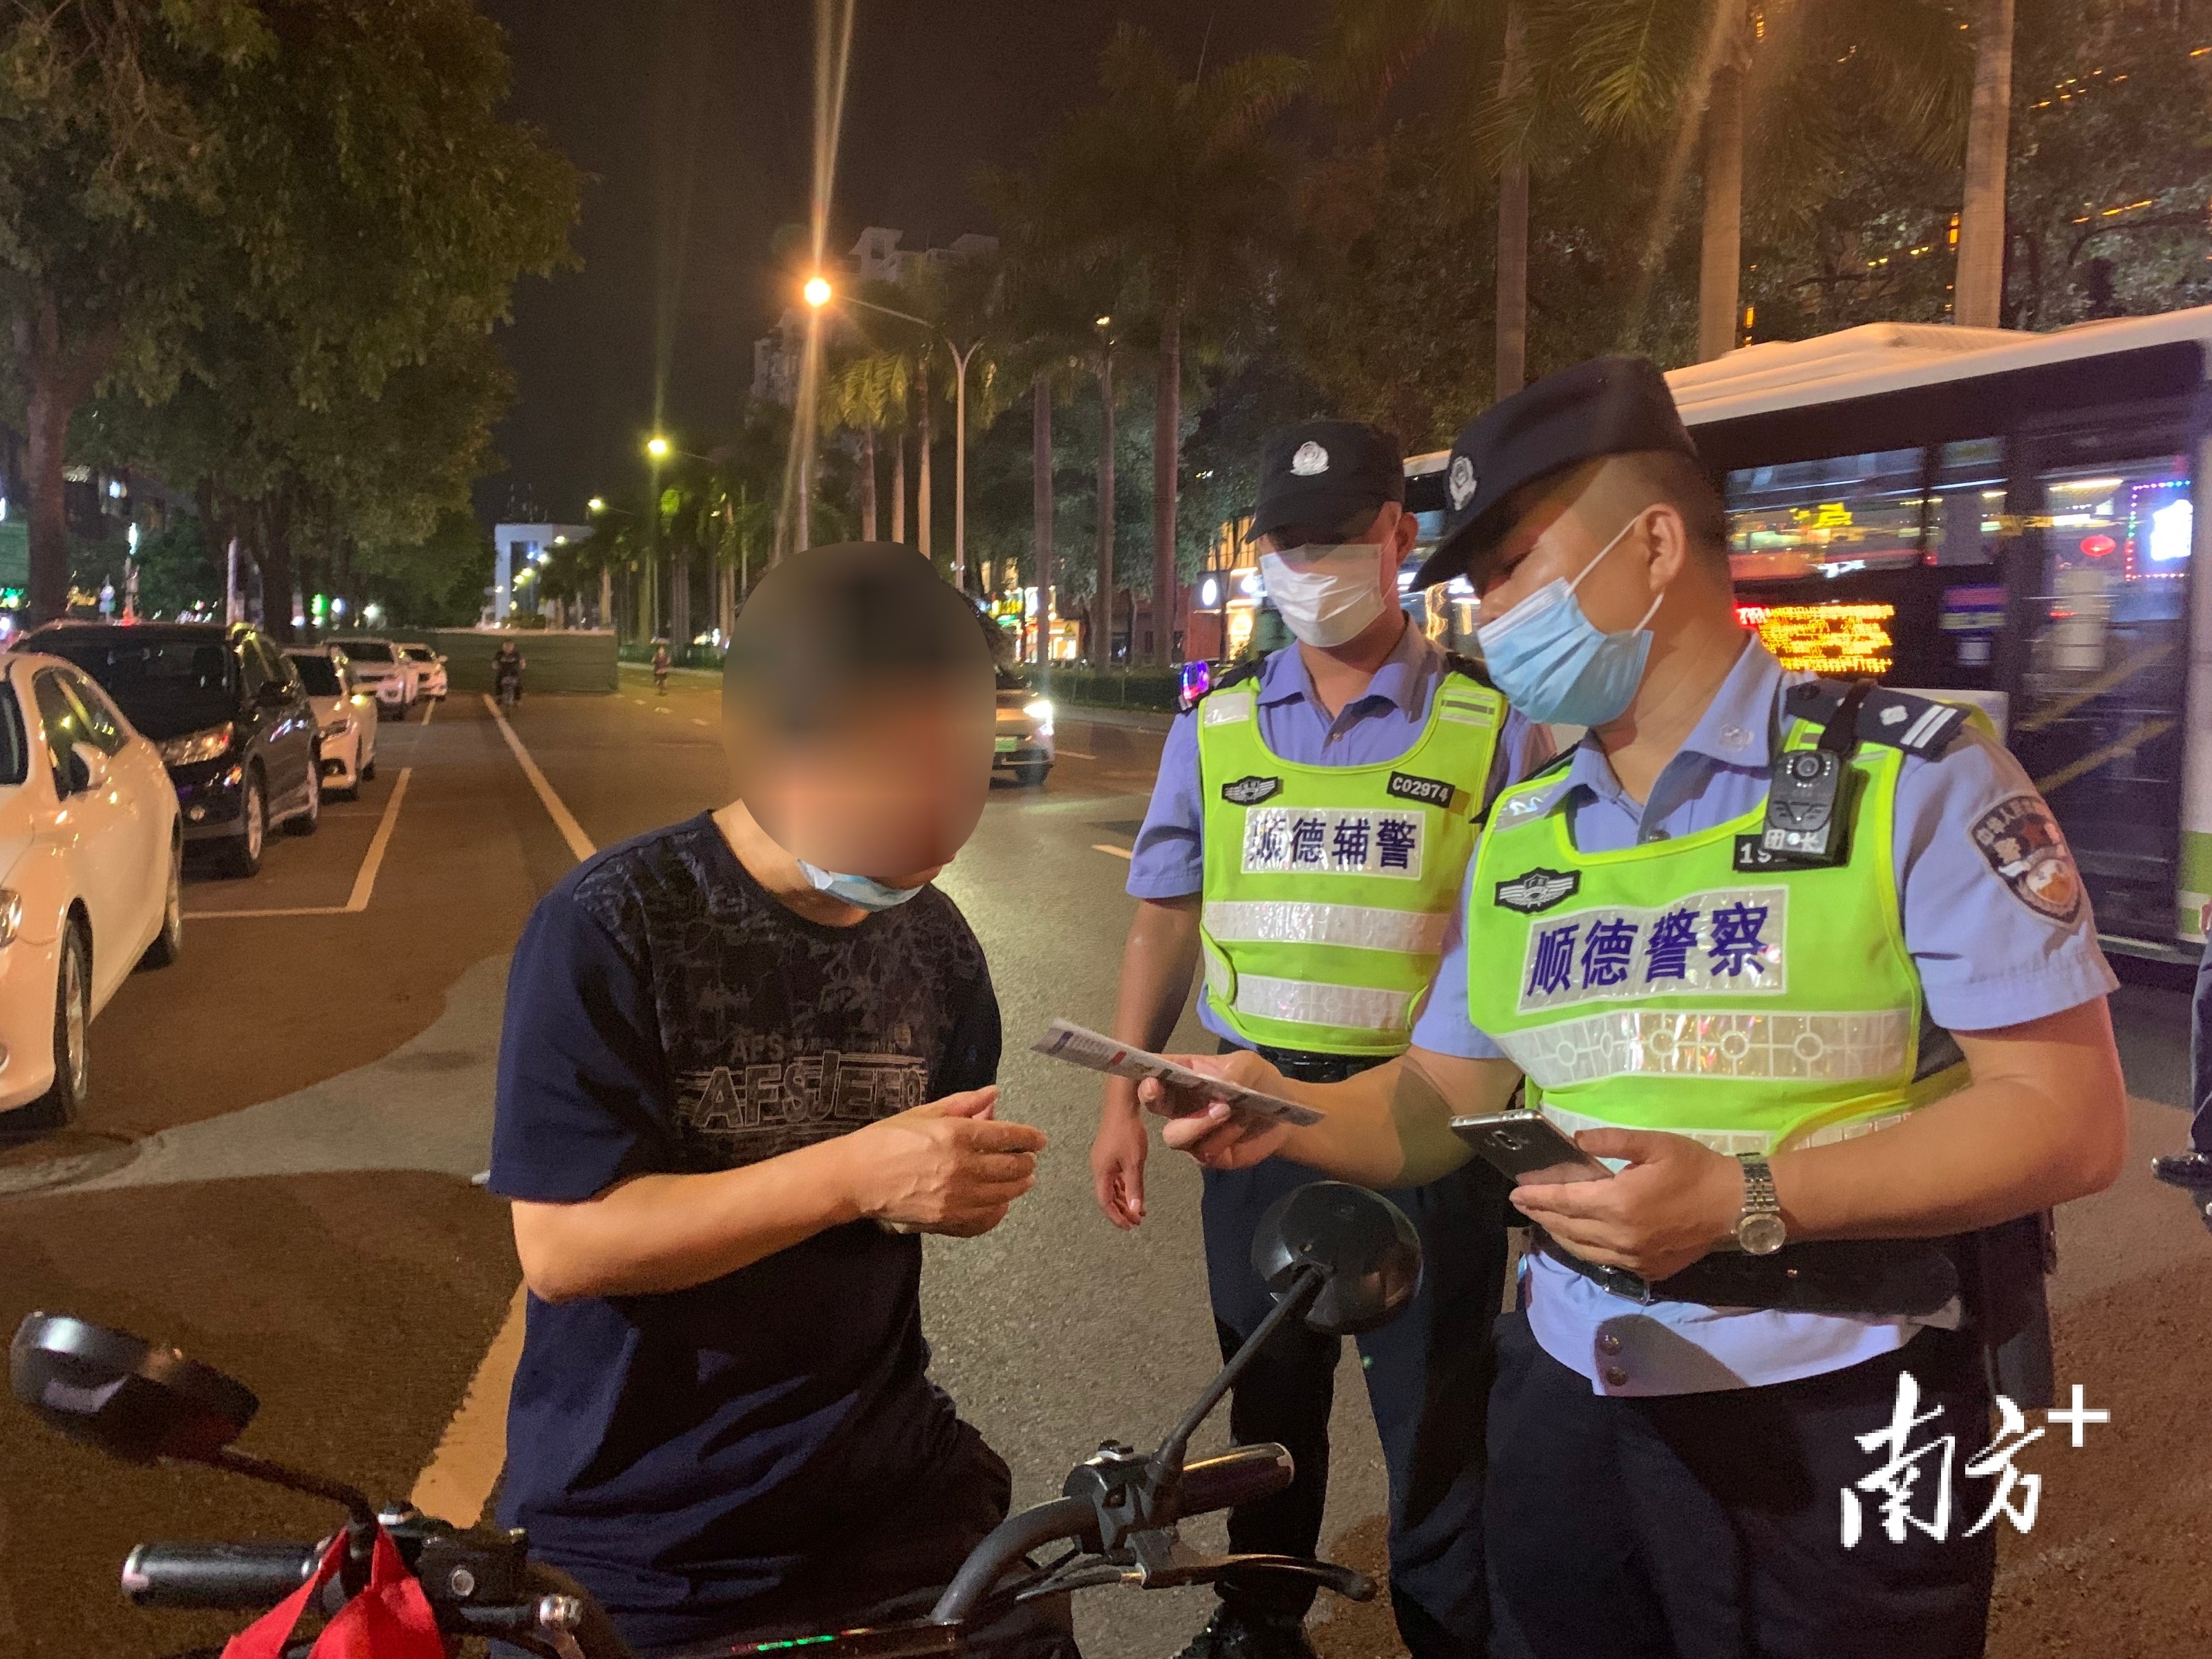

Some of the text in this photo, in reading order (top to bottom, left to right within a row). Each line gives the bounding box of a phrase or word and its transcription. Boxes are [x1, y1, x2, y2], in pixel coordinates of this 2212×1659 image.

[1392, 776, 1449, 802] C02974
[1247, 817, 1417, 870] 顺德辅警
[1526, 901, 1770, 997] 顺德警察
